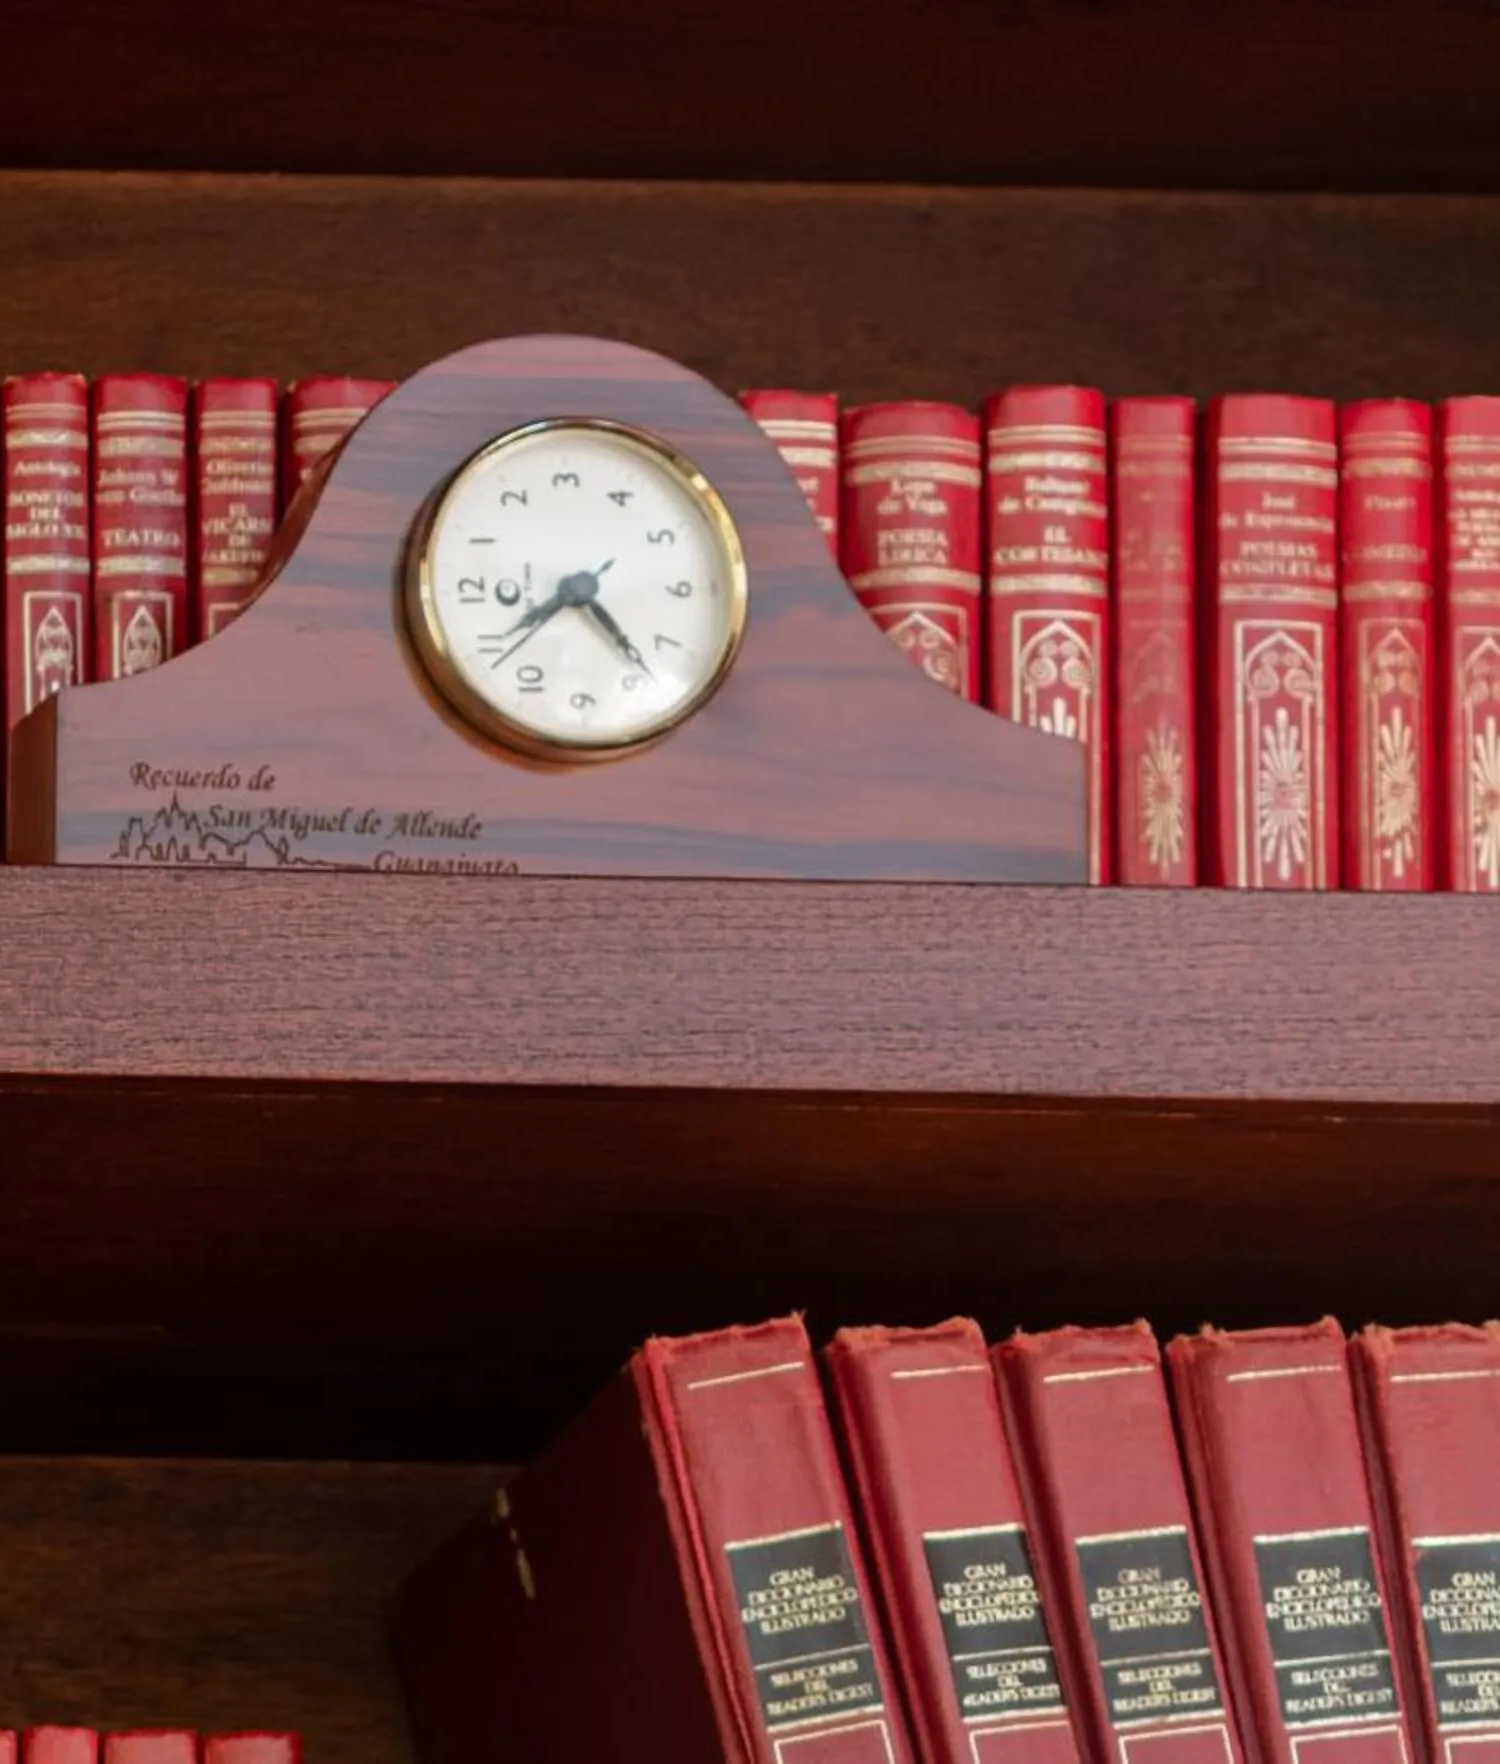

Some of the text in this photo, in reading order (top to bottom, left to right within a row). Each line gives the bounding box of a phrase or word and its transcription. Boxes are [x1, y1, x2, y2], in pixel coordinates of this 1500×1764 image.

[553, 473, 580, 487] 3
[501, 490, 528, 507] 2
[607, 490, 633, 507] 4
[102, 528, 182, 551] TEATRO
[648, 528, 675, 545] 5
[458, 576, 485, 604] 12
[655, 633, 682, 650] 7
[517, 664, 544, 693] 10
[130, 761, 276, 791] Recuerdo de
[204, 804, 483, 841] San Miguel de Allende
[769, 1566, 814, 1585] GRAN
[963, 1561, 1007, 1580] GRAN
[1118, 1565, 1161, 1584] GRAN
[1297, 1566, 1341, 1584] GRAN
[1452, 1570, 1496, 1587] GRAN
